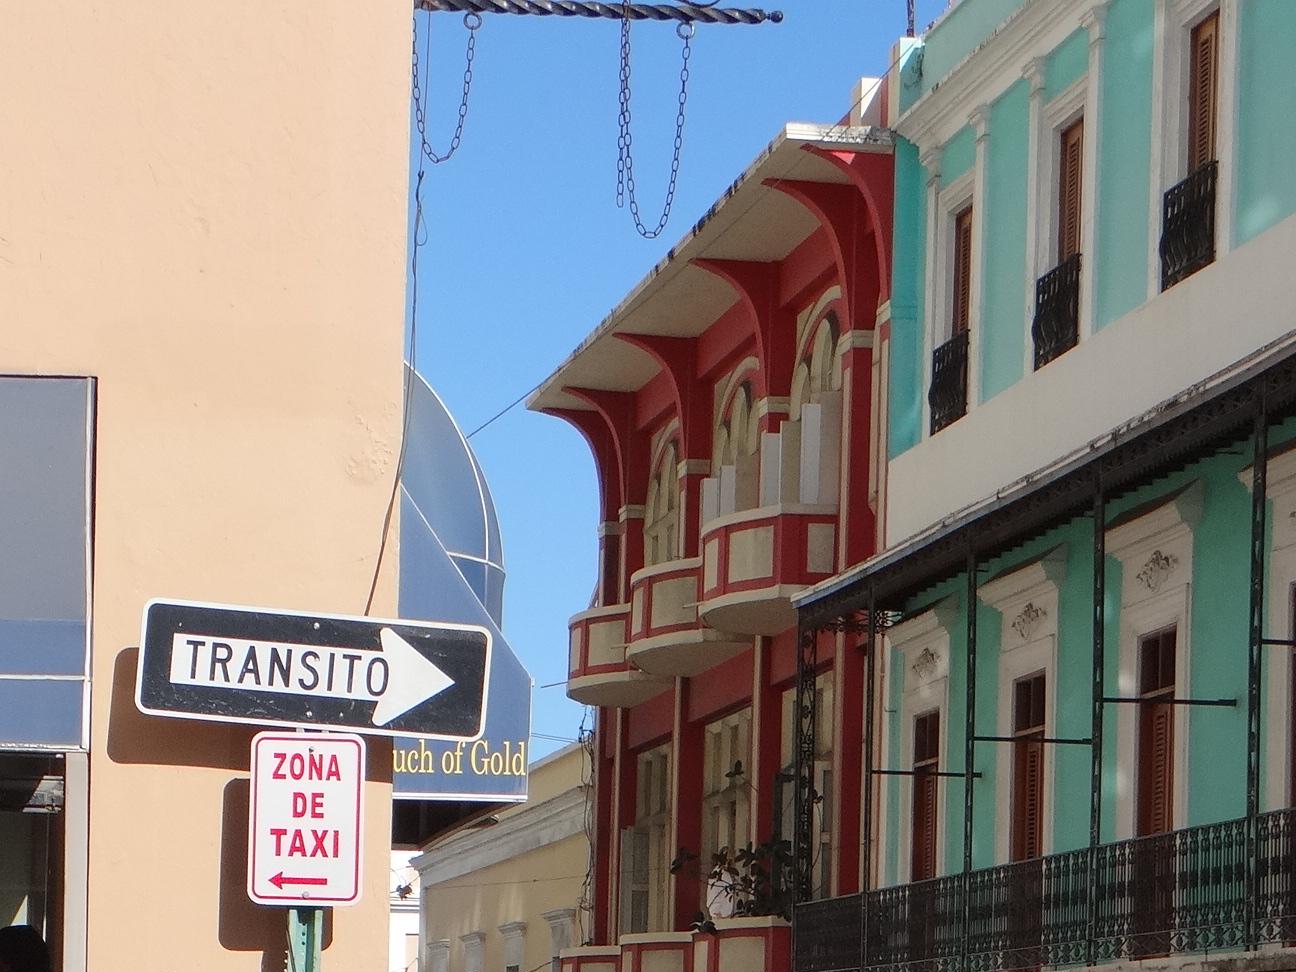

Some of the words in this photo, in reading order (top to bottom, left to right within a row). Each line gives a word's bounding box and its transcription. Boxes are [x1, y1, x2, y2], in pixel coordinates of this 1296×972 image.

[186, 639, 390, 697] TRANSITO
[272, 752, 343, 782] ZONA
[441, 741, 466, 775] of
[470, 740, 527, 776] Gold
[292, 792, 326, 819] DE
[270, 829, 341, 859] TAXI
